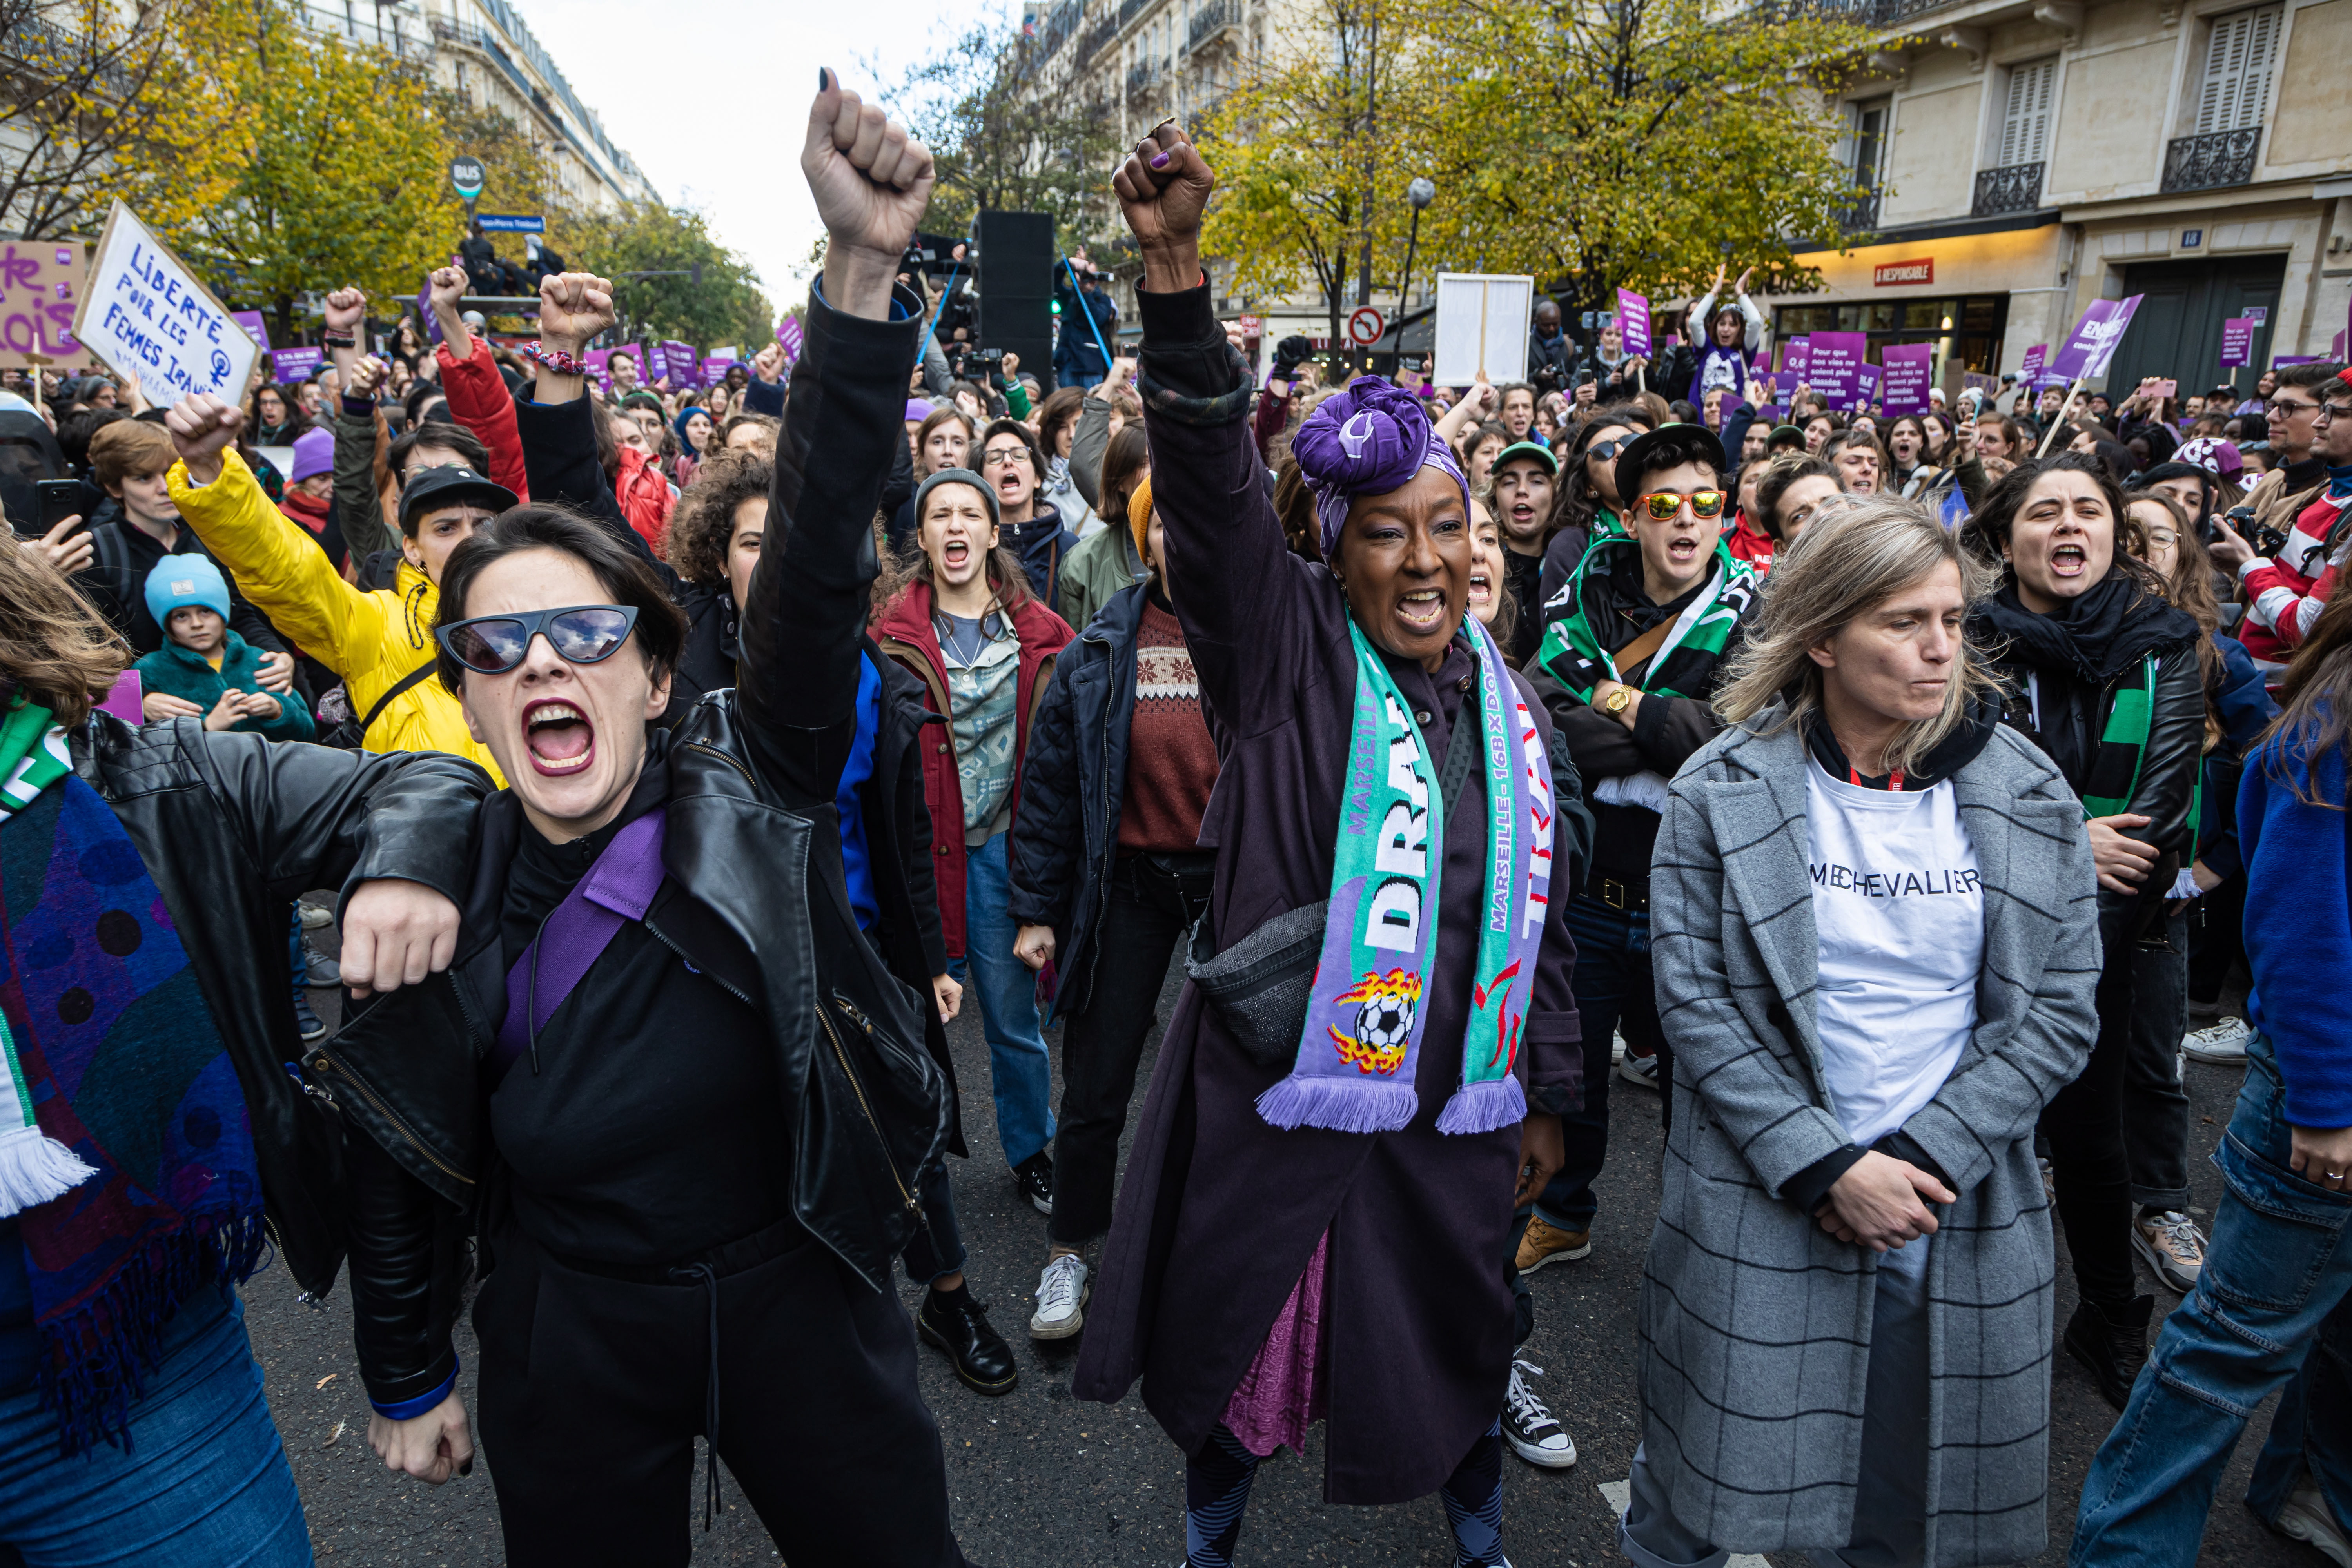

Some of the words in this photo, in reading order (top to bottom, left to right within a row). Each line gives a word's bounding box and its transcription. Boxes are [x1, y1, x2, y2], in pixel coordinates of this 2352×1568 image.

[454, 165, 481, 181] BUS
[2185, 232, 2198, 246] 18
[1882, 264, 1929, 282] RESPONSABLE
[116, 272, 154, 321] POUR
[158, 313, 187, 346] LES
[0, 297, 82, 356] ois
[103, 301, 163, 367] FEMMES
[1813, 348, 1831, 357] Pour
[1828, 358, 1844, 367] vies
[1810, 367, 1834, 376] soient
[1835, 368, 1853, 378] plus
[1809, 377, 1841, 387] classées
[1907, 377, 1922, 386] plus
[1827, 387, 1847, 397] suite
[1902, 395, 1920, 404] suite
[1487, 712, 1503, 734] X
[1348, 681, 1376, 835] MARSEILLE
[1490, 735, 1508, 780] 16B
[1490, 795, 1511, 932] MARSEILLE
